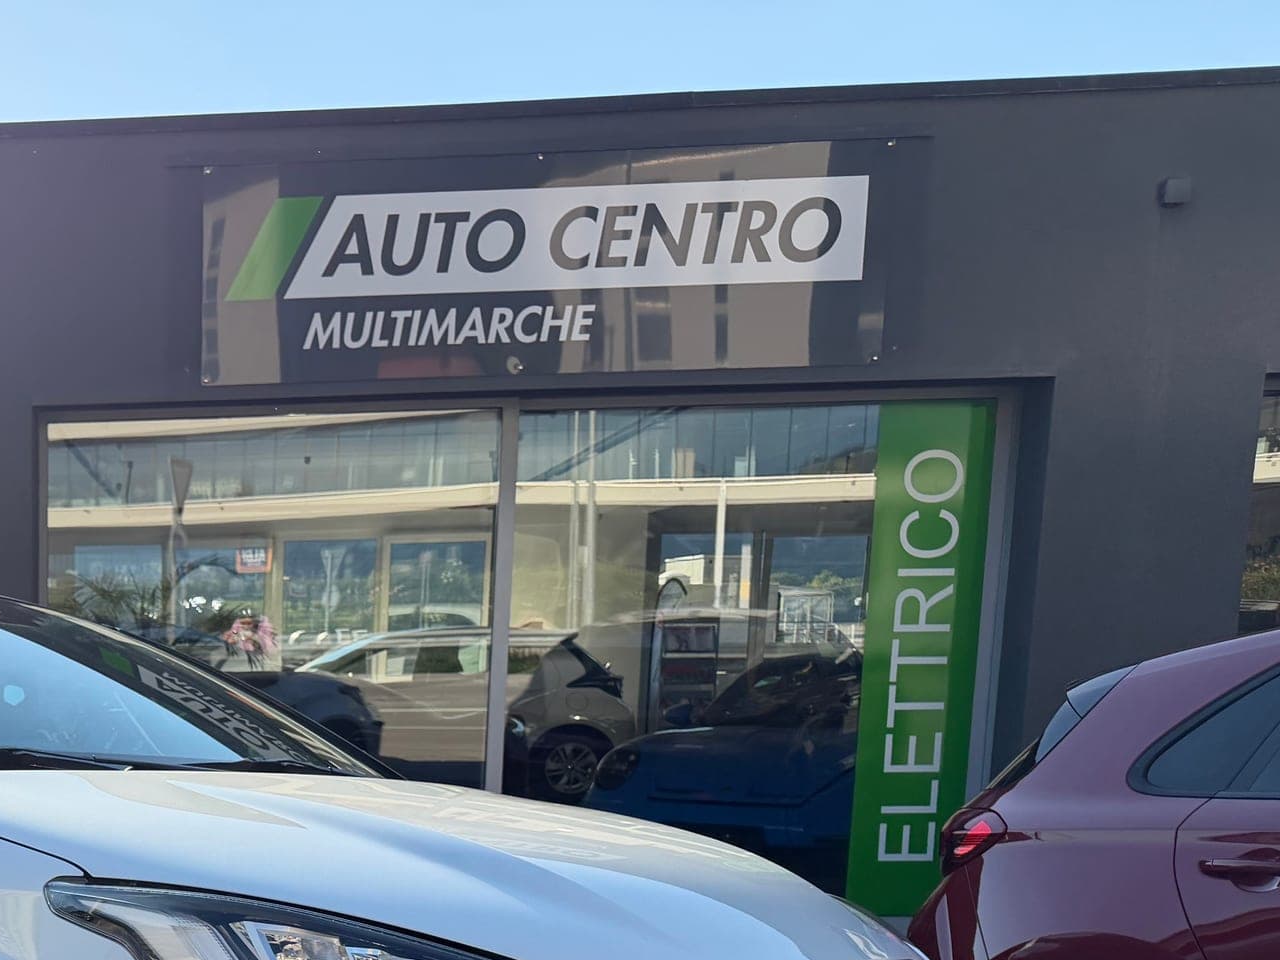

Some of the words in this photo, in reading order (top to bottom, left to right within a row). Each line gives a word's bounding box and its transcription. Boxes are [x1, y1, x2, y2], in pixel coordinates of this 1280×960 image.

[321, 208, 526, 277] AUTO
[549, 196, 842, 271] CENTRO
[303, 304, 596, 350] MULTIMARCHE
[877, 448, 964, 862] ELETTRICO
